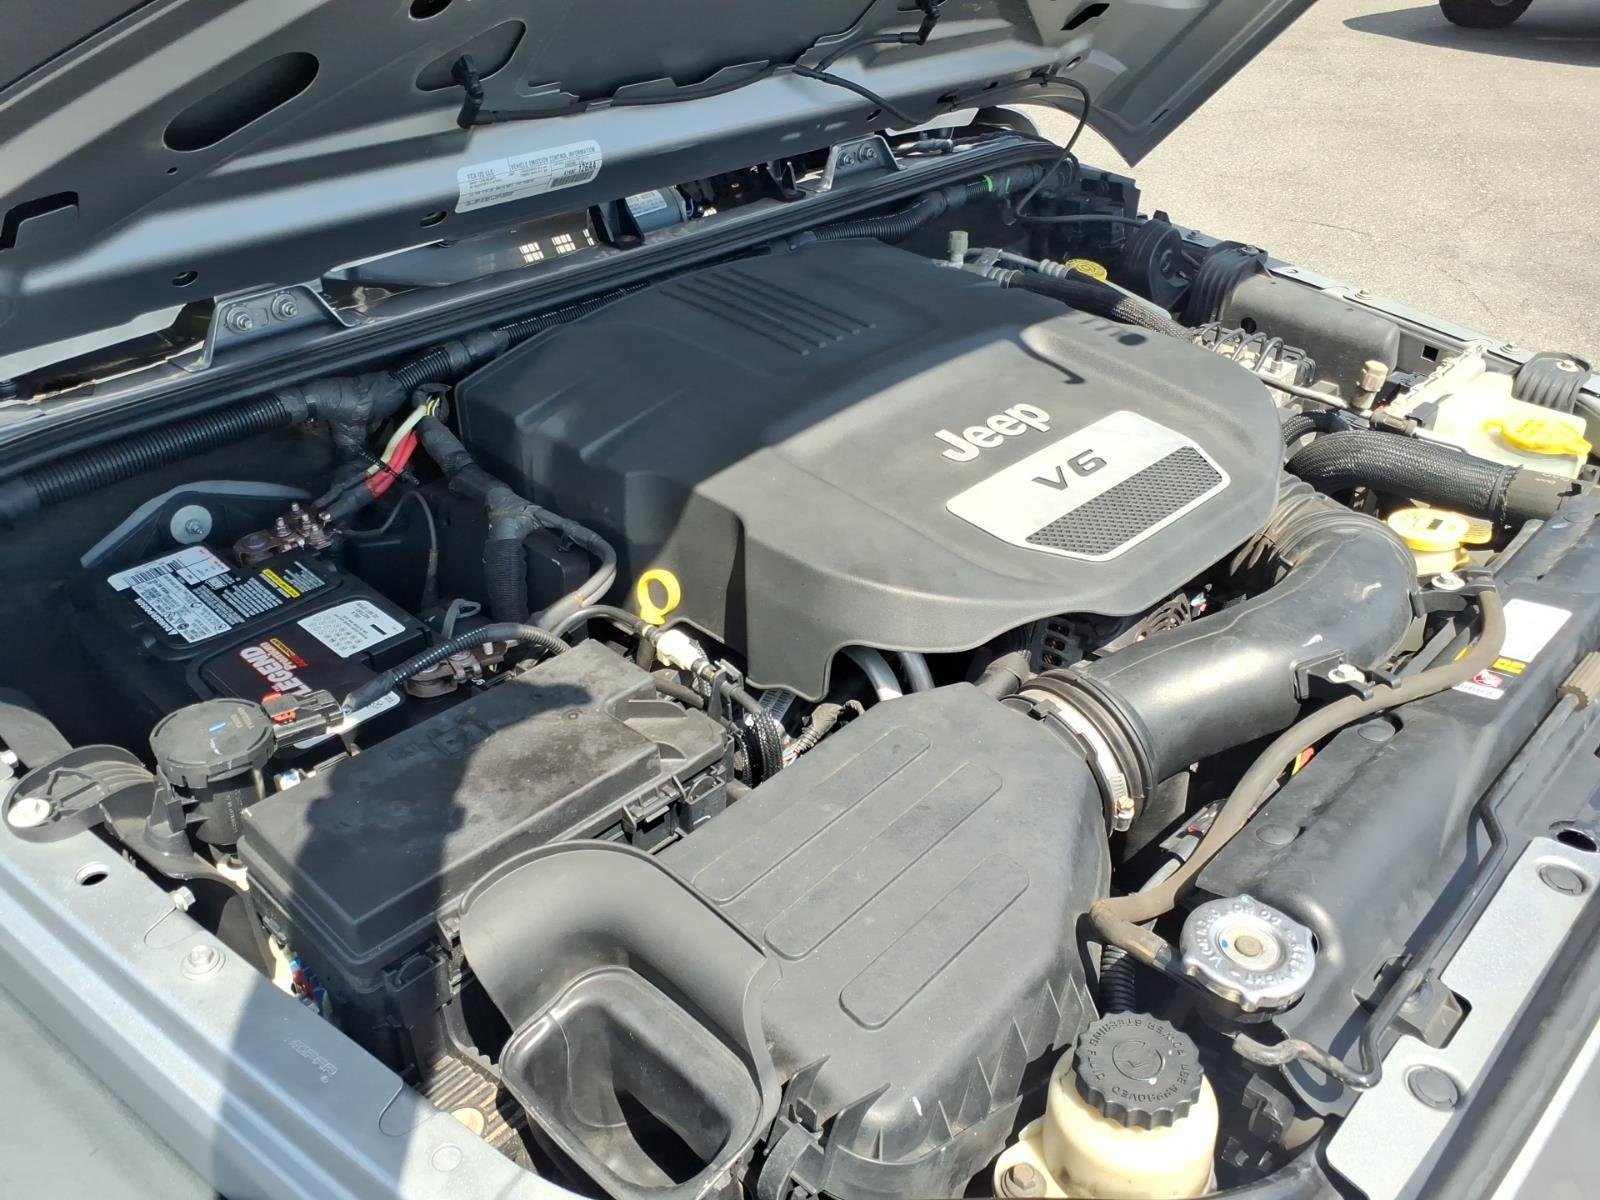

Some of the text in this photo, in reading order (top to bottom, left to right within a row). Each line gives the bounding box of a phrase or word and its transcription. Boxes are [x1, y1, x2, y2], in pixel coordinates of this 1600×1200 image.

[934, 403, 1051, 462] Jeep
[1031, 449, 1107, 491] V6
[239, 646, 314, 698] LEGEND
